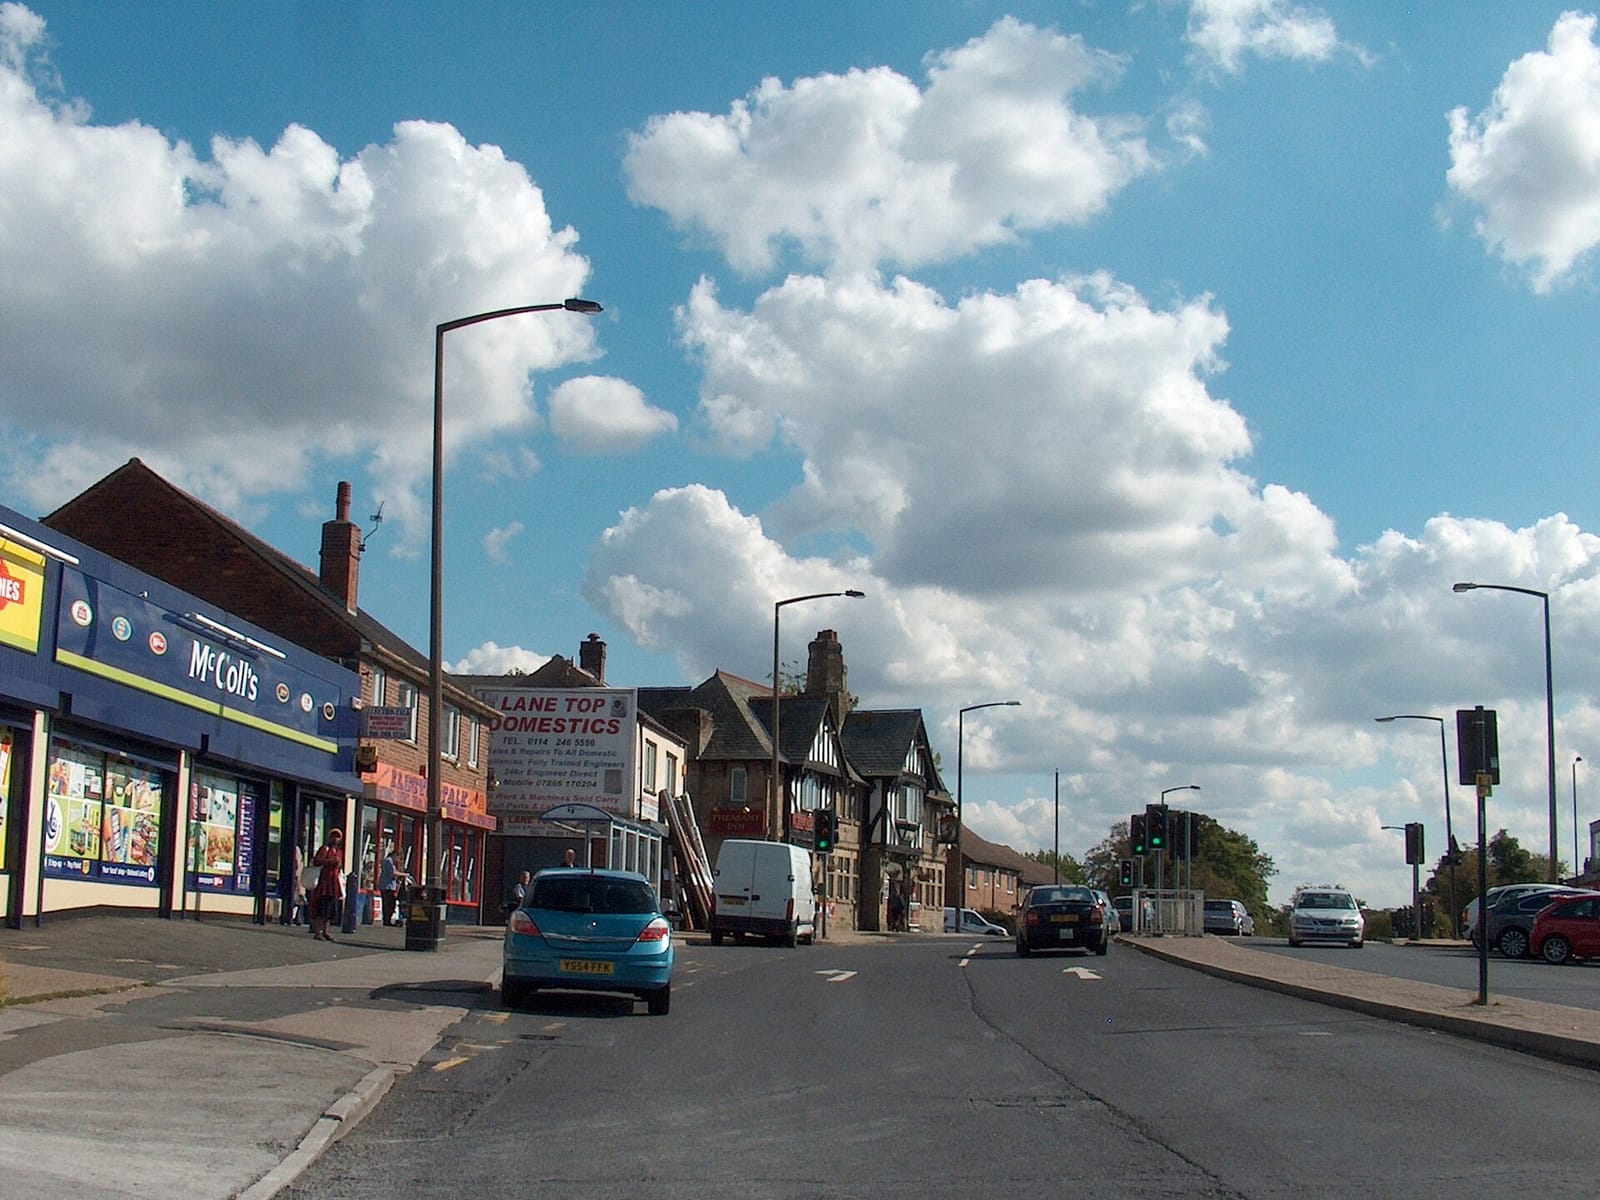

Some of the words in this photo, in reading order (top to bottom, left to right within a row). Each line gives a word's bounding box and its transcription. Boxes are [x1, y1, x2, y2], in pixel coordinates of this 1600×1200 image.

[188, 640, 259, 701] McColl's
[501, 696, 557, 712] LANE
[565, 697, 606, 713] TOP
[489, 716, 621, 735] DOMESTICS
[527, 738, 548, 746] 0114
